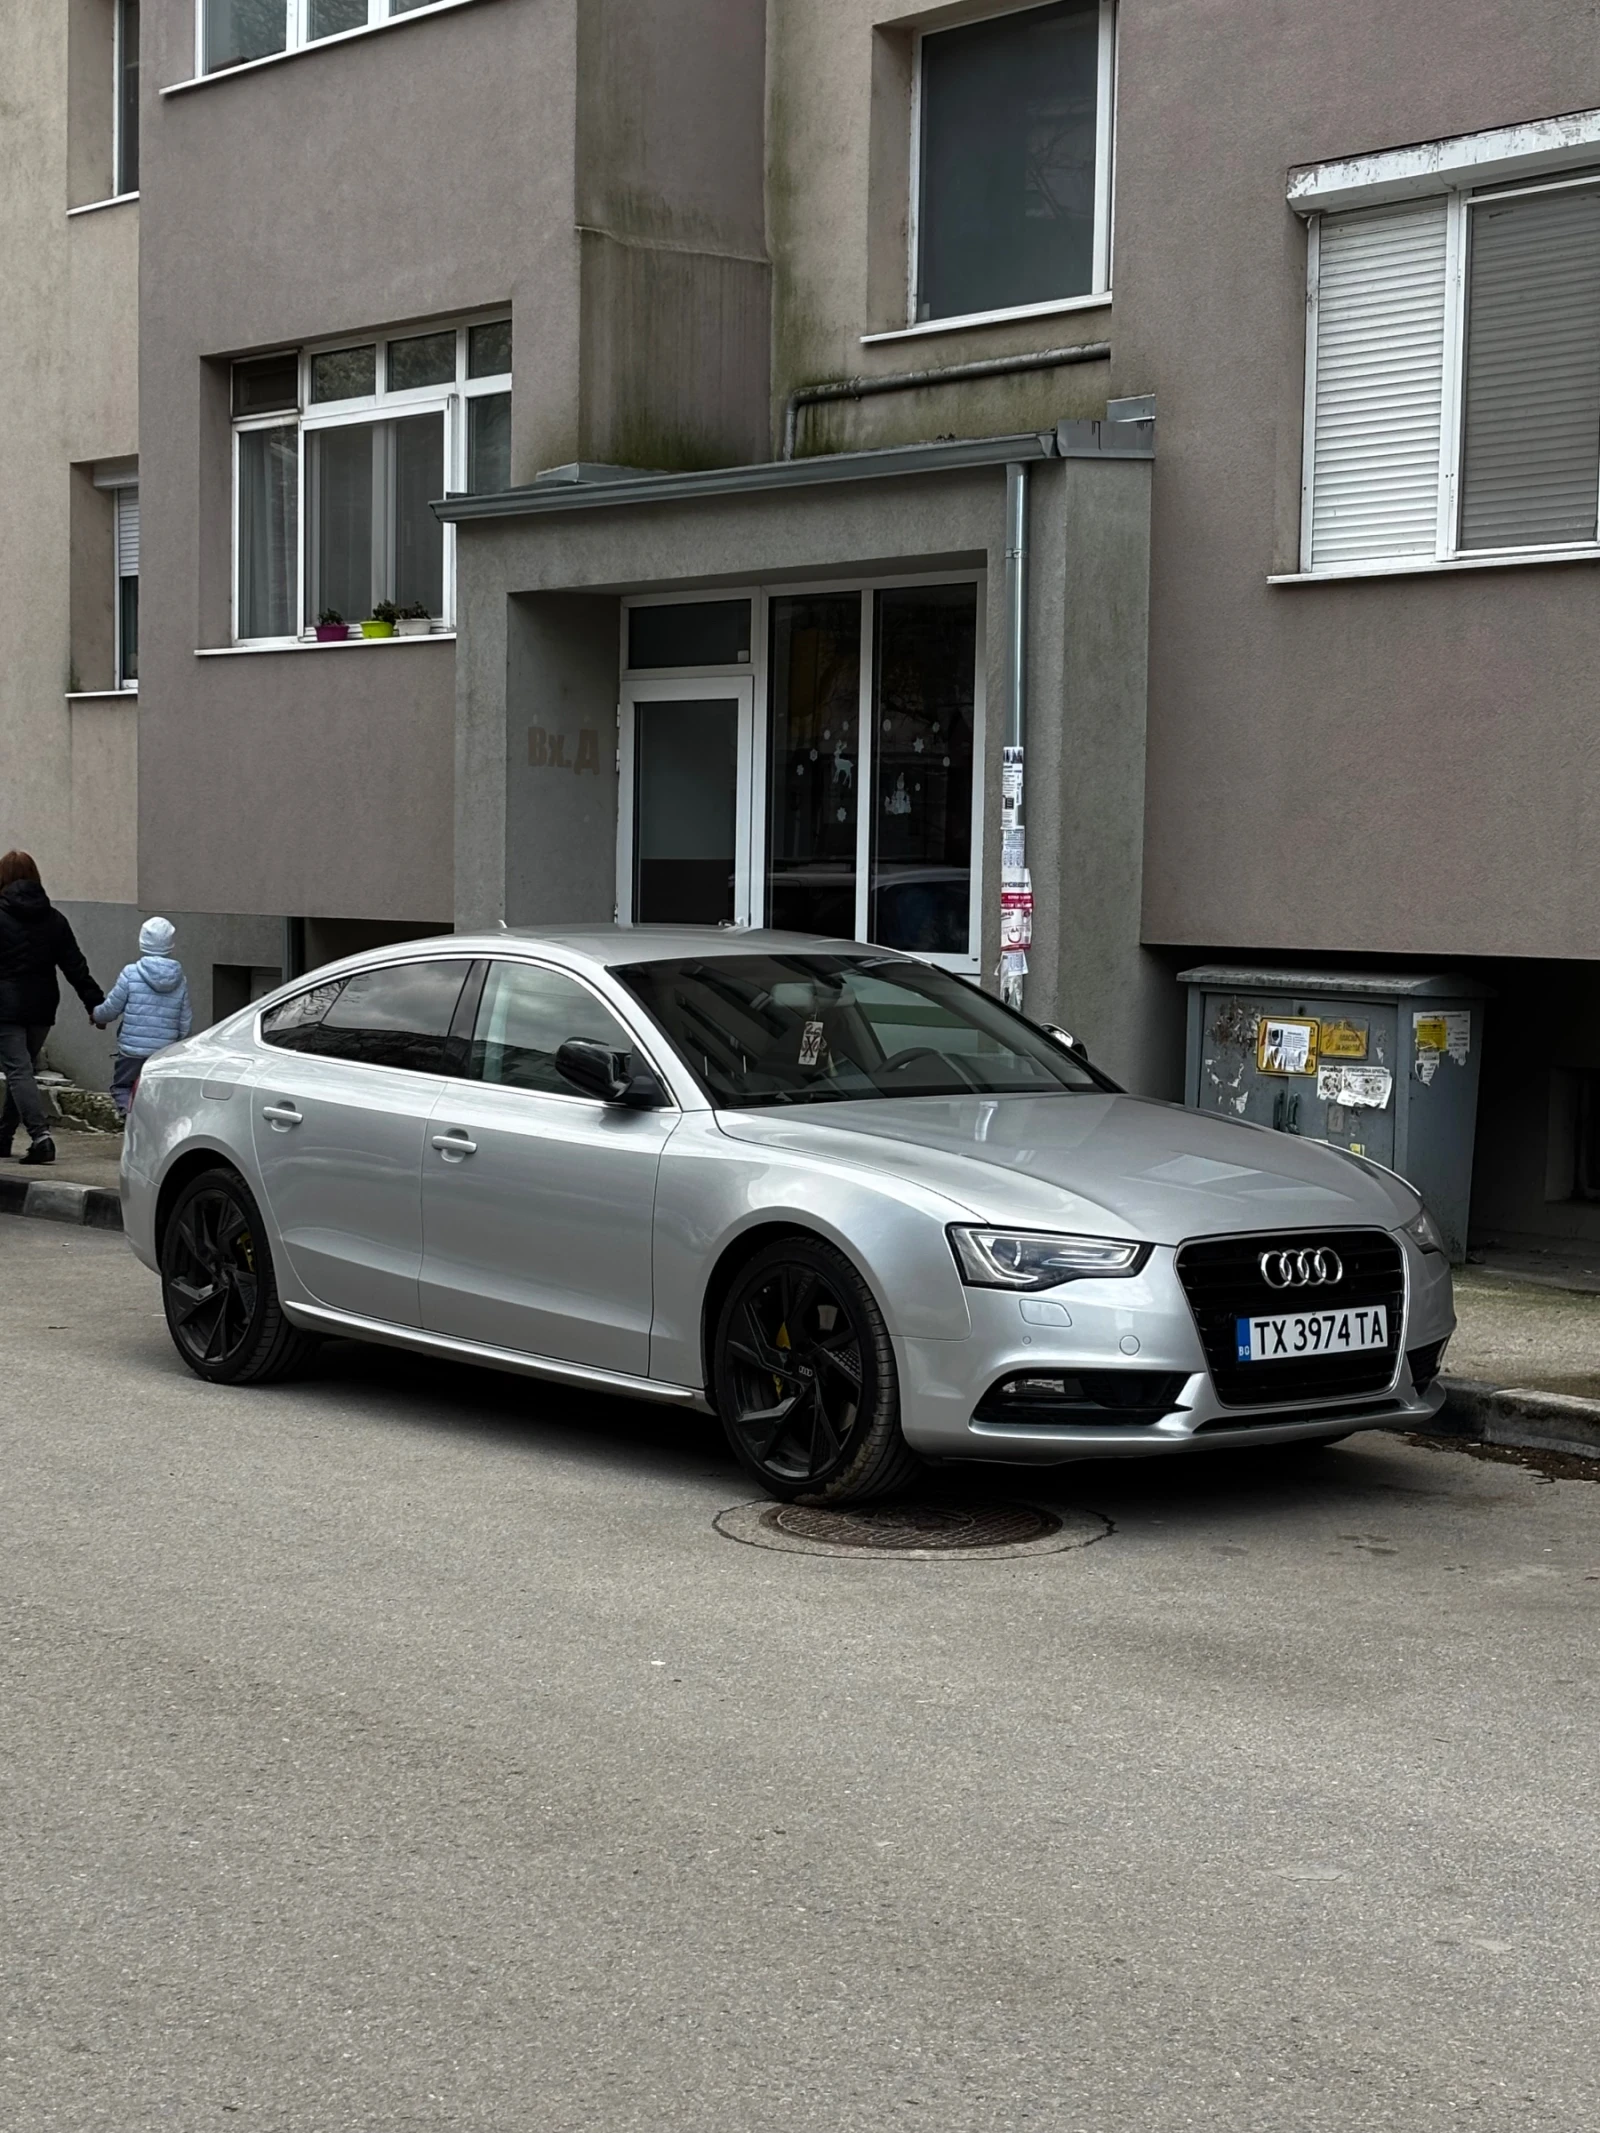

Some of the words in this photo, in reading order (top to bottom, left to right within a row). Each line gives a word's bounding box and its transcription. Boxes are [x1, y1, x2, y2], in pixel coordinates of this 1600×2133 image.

[1238, 1345, 1250, 1356] BG
[1254, 1319, 1288, 1355] TX
[1294, 1314, 1351, 1351] 3974
[1355, 1310, 1384, 1345] TA
